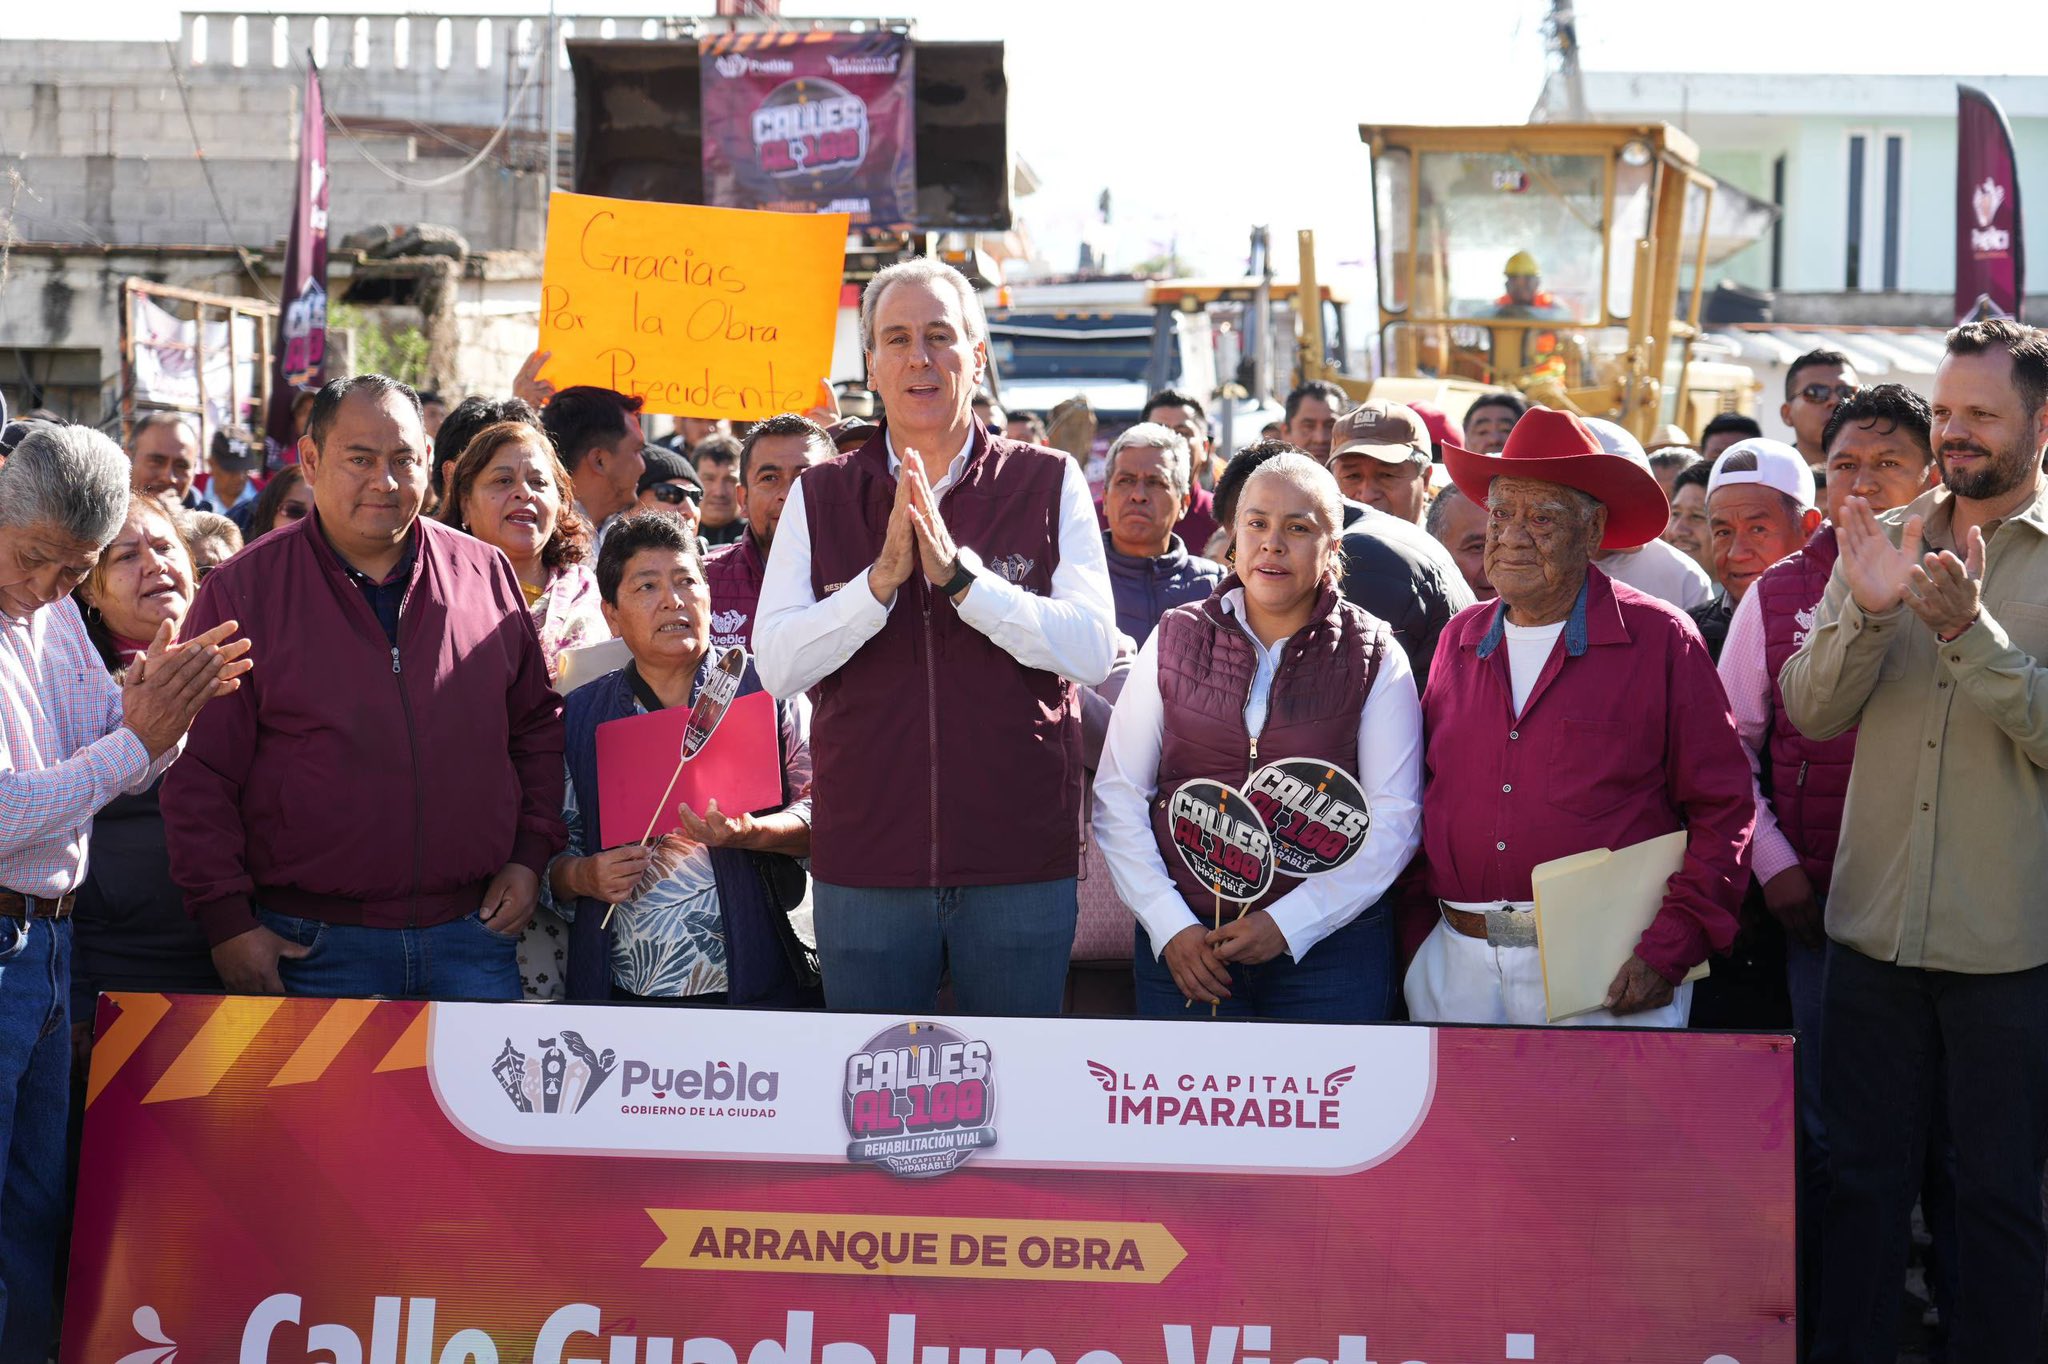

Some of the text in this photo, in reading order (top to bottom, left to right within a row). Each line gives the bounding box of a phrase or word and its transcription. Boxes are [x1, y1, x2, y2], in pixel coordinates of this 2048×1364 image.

[753, 98, 863, 143] CALLES
[580, 211, 746, 294] Gracias
[541, 284, 779, 343] Por la Obra
[1252, 766, 1369, 840] CALLES
[1173, 790, 1269, 860] CALLES
[1279, 809, 1349, 859] 100
[1174, 815, 1261, 882] AL 100
[1272, 848, 1310, 872] ARABLE
[1273, 842, 1309, 863] CAPITAL
[1194, 863, 1243, 897] IMPARABLE
[1208, 867, 1242, 887] CAPITAL
[621, 1060, 779, 1102] Puebla
[848, 1040, 988, 1094] CALLES
[1123, 1073, 1319, 1095] LA CAPITAL
[621, 1105, 777, 1118] GOBIERNO DE LA CIUDAD
[853, 1078, 984, 1133] AL 100
[1108, 1095, 1340, 1130] IMPARABLE
[864, 1131, 981, 1157] REHABILITACIÓN VIAL
[896, 1160, 953, 1174] IMPARABLE
[688, 1226, 1146, 1272] ARRANQUE DE OBRA
